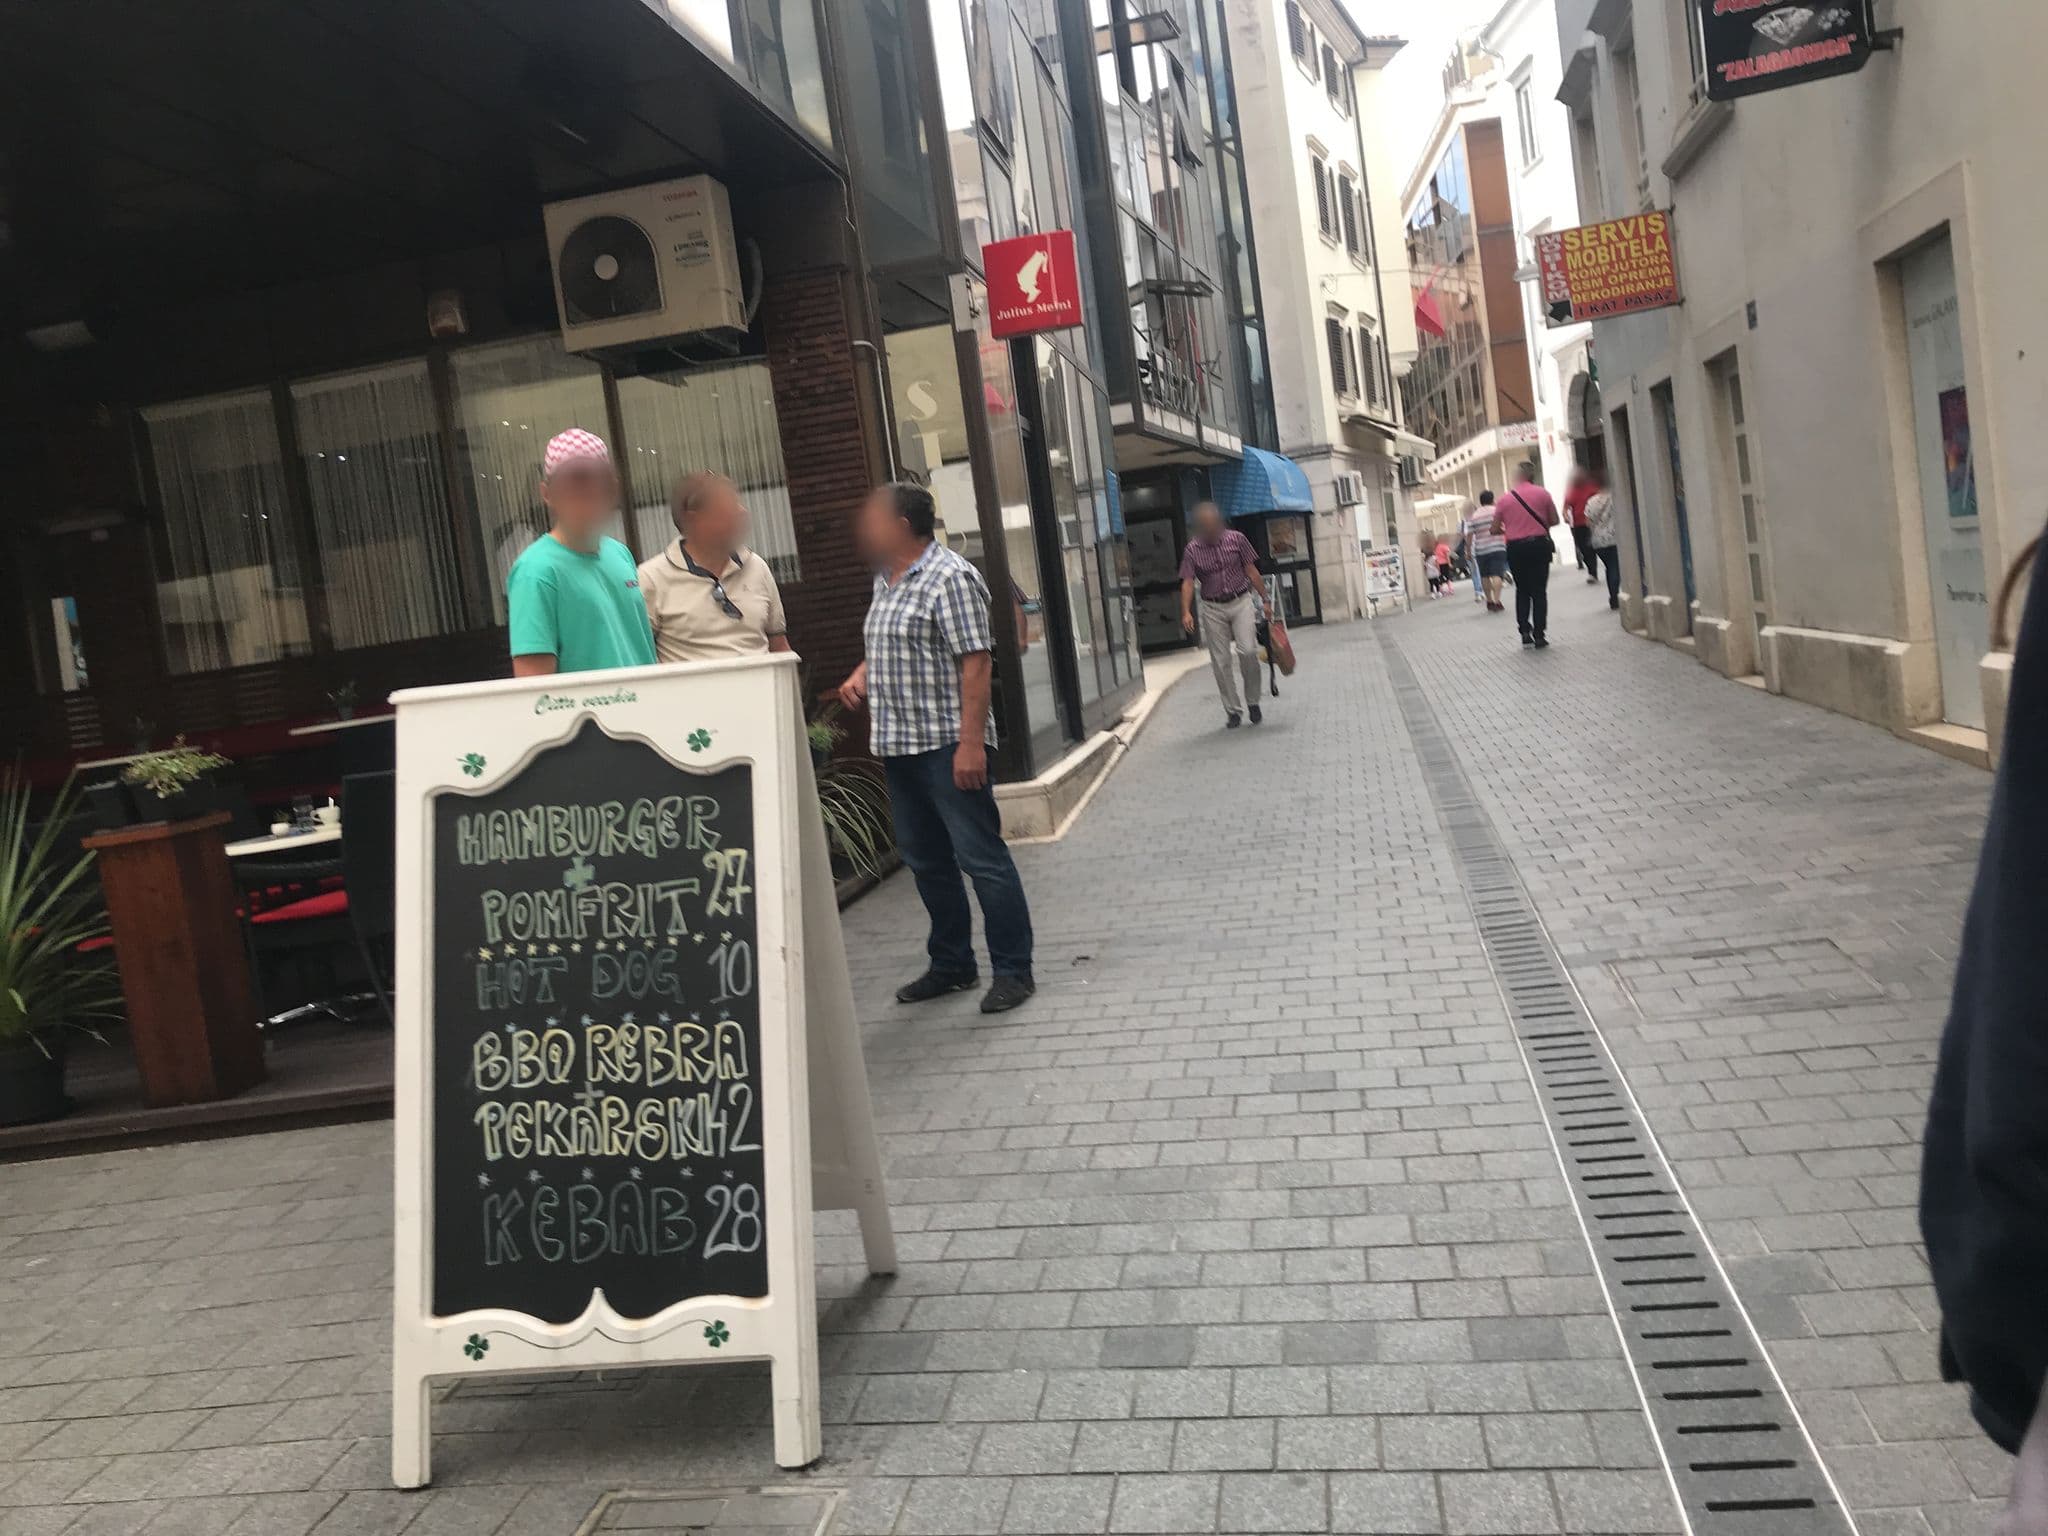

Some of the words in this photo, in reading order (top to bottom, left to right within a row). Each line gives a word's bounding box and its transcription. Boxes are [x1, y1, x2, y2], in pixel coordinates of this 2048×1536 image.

[1564, 213, 1666, 251] SERVIS
[1566, 235, 1668, 271] MOBITELA
[1568, 253, 1670, 281] KOMPJUTORA
[1571, 278, 1604, 293] GSM
[1608, 265, 1671, 286] OPREMA
[1572, 276, 1674, 304] DEKODIRANJE
[997, 305, 1034, 321] Julius
[1037, 299, 1073, 314] Meinl
[457, 795, 722, 866] HAMBURGER
[480, 877, 701, 944] POMFRIT
[703, 847, 753, 918] 27
[476, 955, 569, 1011] HOT
[592, 949, 686, 1004] DOG
[706, 939, 753, 1004] 10
[472, 1028, 576, 1092] BBQ
[585, 1021, 749, 1088] REBRA
[474, 1093, 715, 1162] PEKARSKI
[711, 1080, 762, 1159] 42
[480, 1180, 698, 1266] KEBAB
[703, 1182, 762, 1260] 28
